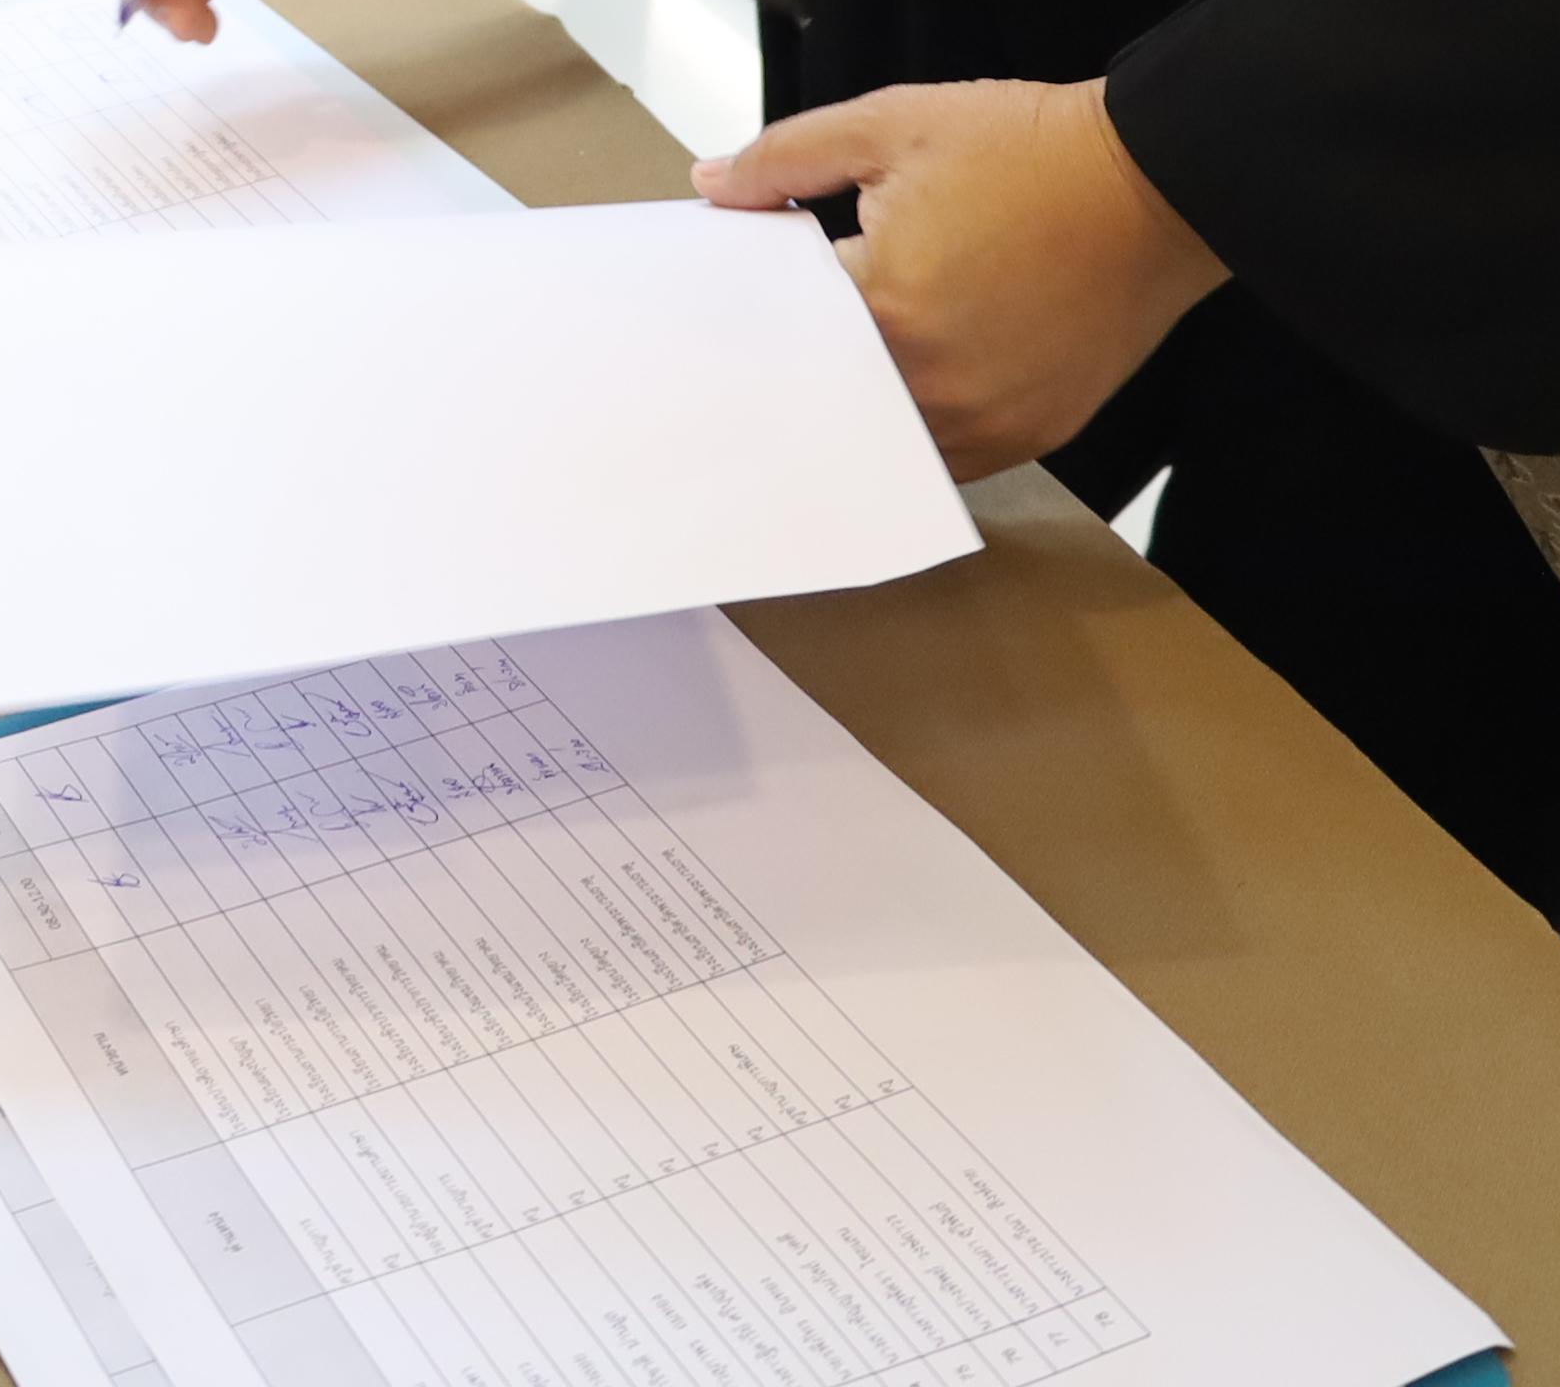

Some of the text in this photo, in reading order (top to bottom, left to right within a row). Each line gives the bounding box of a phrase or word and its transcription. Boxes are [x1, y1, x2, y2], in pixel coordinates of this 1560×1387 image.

[19, 877, 62, 931] 08.30-12.00
[93, 1031, 129, 1077] หน่วยงาน
